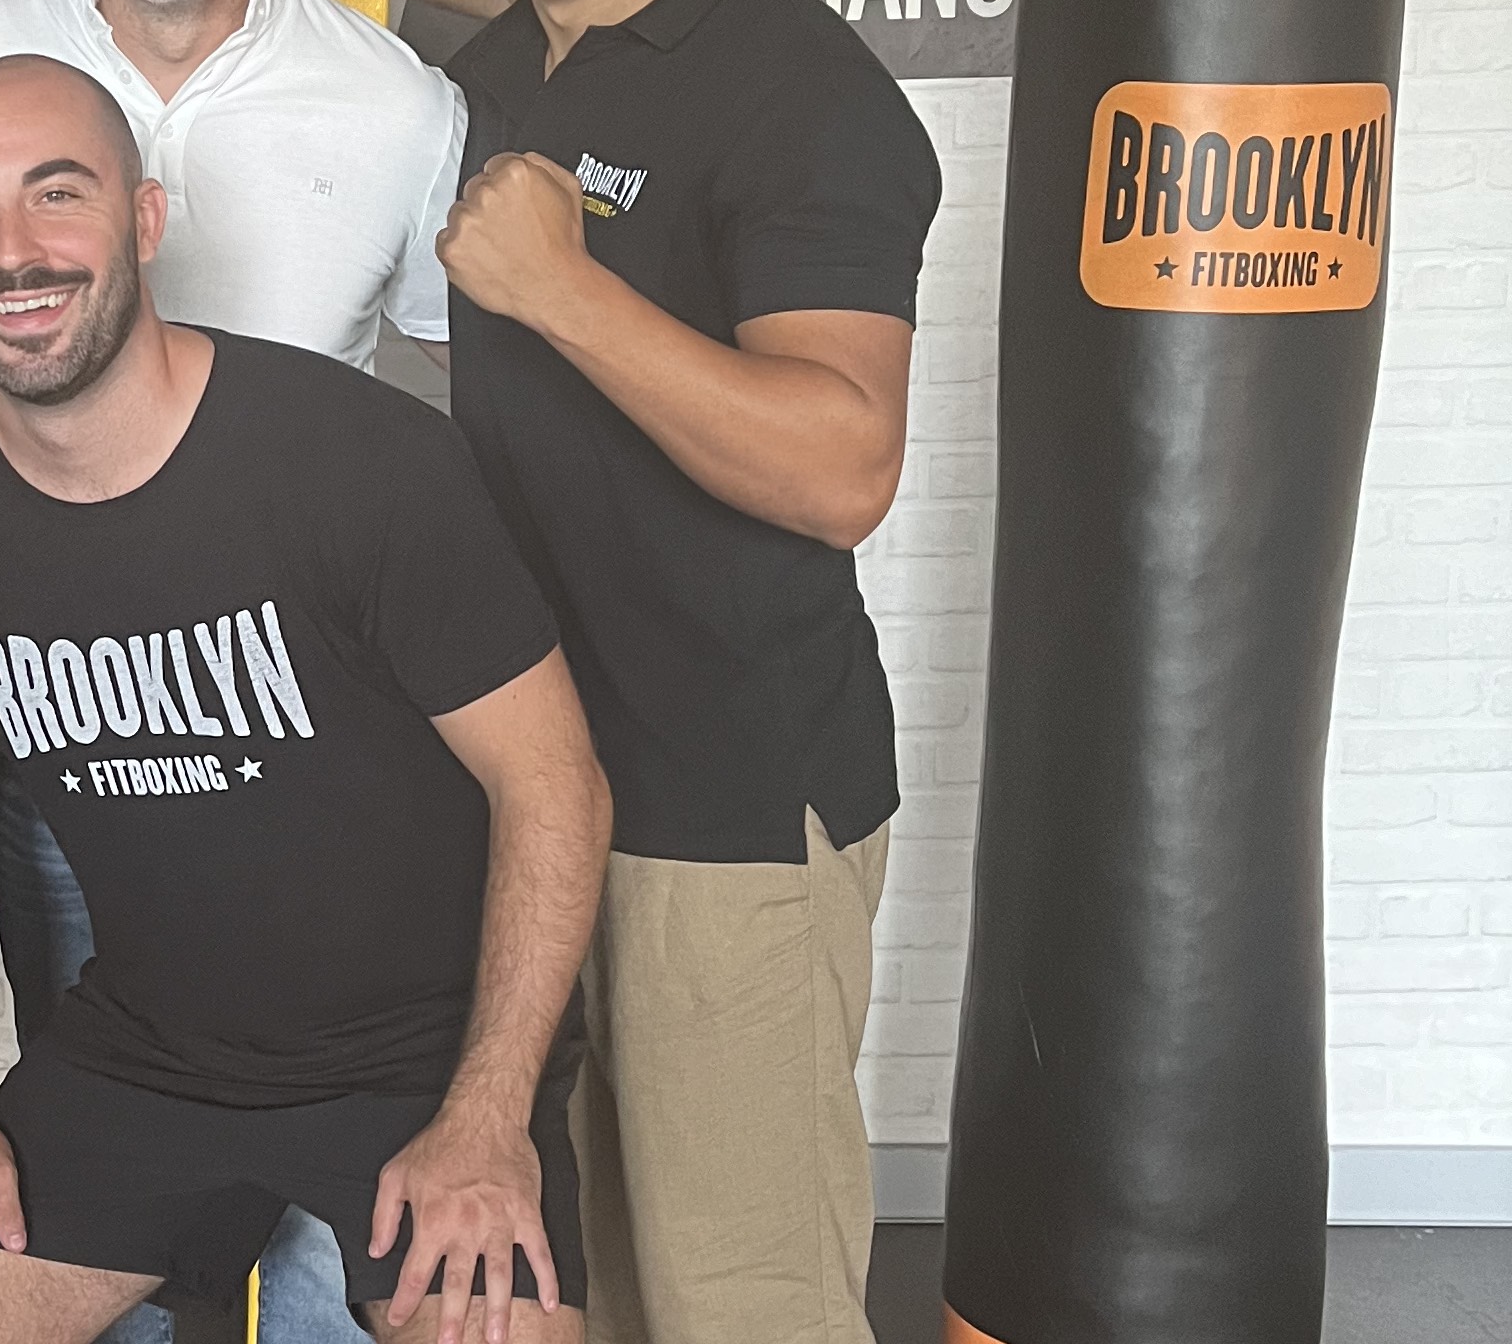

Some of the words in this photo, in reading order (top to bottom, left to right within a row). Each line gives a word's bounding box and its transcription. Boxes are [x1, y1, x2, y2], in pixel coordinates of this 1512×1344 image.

[1102, 109, 1386, 247] BROOKLYN
[1191, 251, 1319, 288] FITBOXING
[87, 755, 229, 797] FITBOXING
